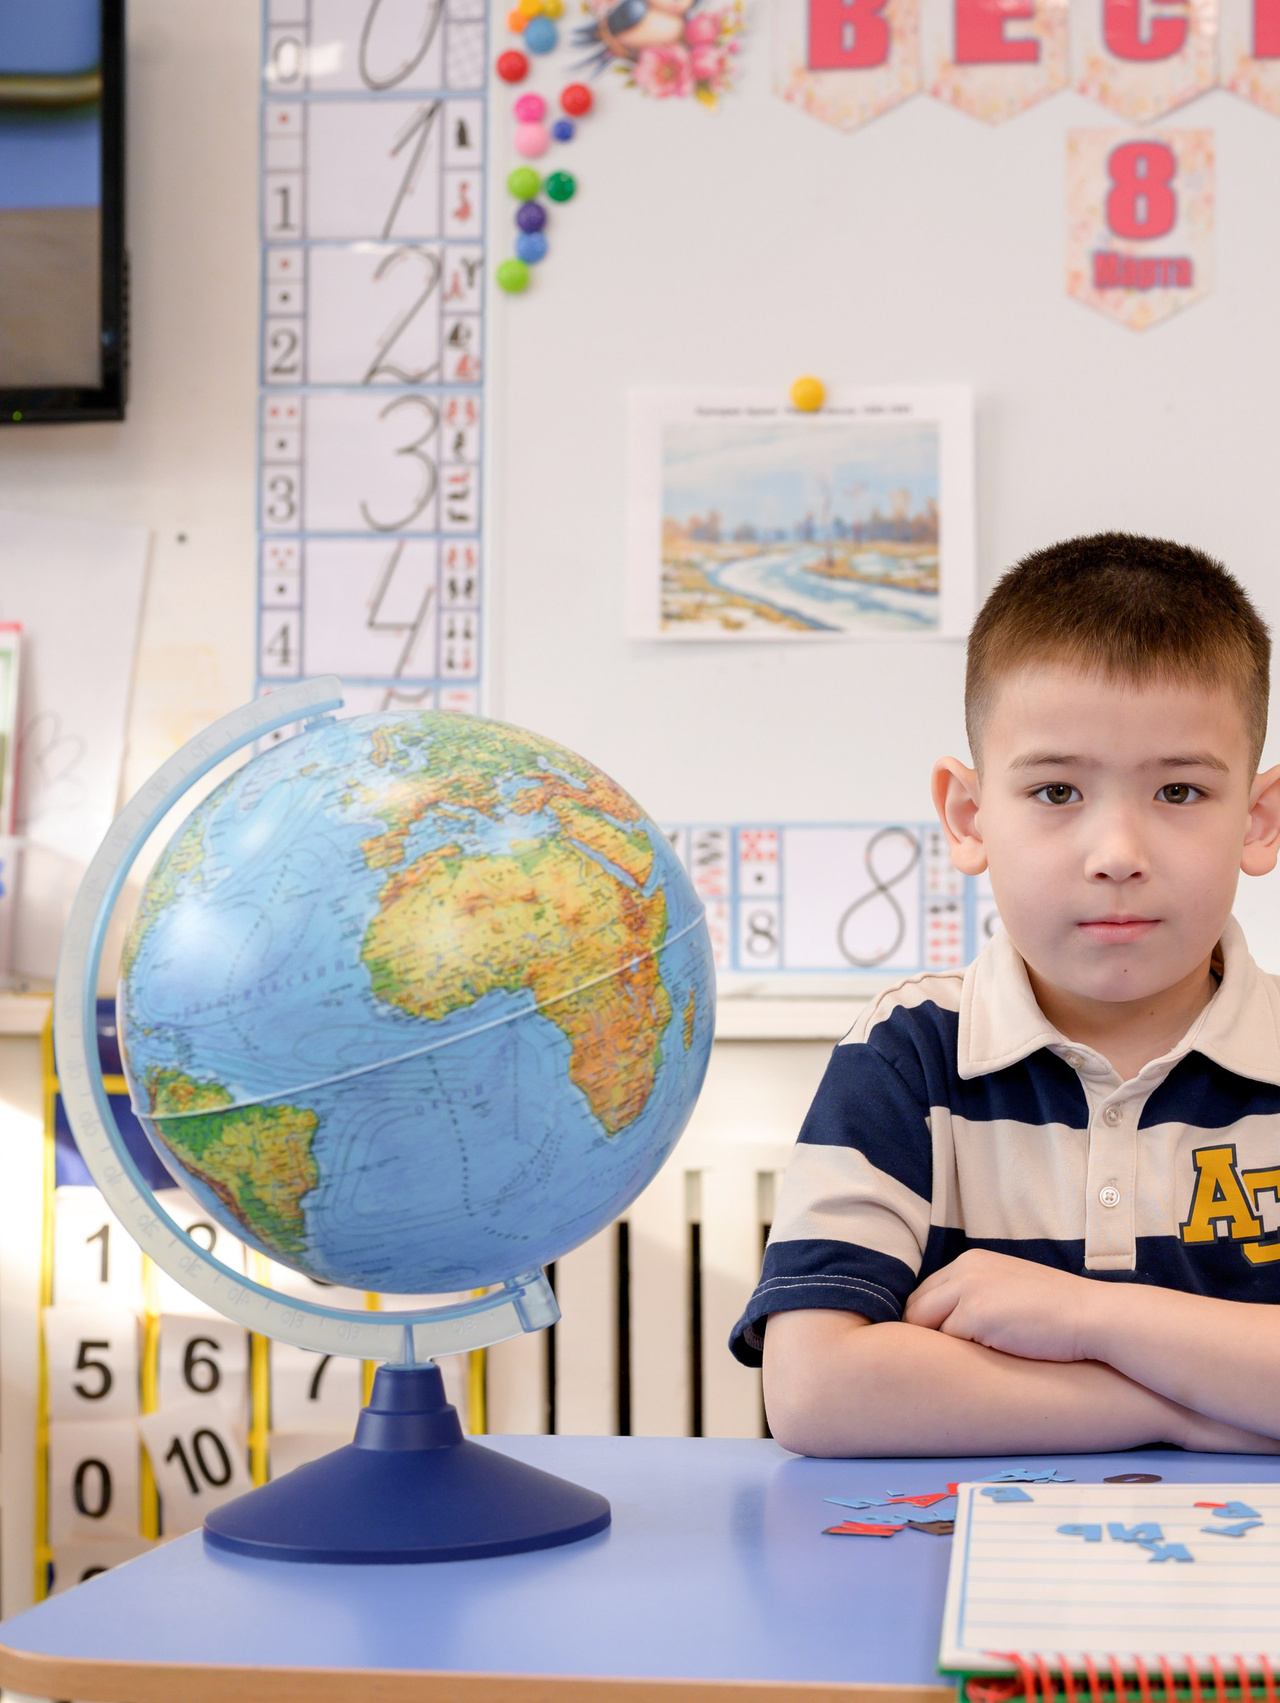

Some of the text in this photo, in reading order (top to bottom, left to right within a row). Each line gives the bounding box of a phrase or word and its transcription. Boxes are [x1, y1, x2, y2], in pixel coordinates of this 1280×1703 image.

[382, 99, 442, 239] 1
[1106, 140, 1178, 241] 8
[274, 186, 291, 231] 1
[1093, 251, 1193, 290] Марта
[363, 245, 440, 385] 2
[269, 329, 298, 374] 2
[360, 394, 440, 532] 3
[267, 475, 296, 523] 3
[365, 539, 436, 678] 4
[266, 623, 295, 667] 4
[837, 826, 922, 967] 8
[746, 911, 777, 959] 8
[86, 1223, 111, 1283] 1
[73, 1340, 114, 1401] 5
[182, 1336, 222, 1394] 6
[72, 1457, 113, 1520] 0
[165, 1427, 233, 1496] 10
